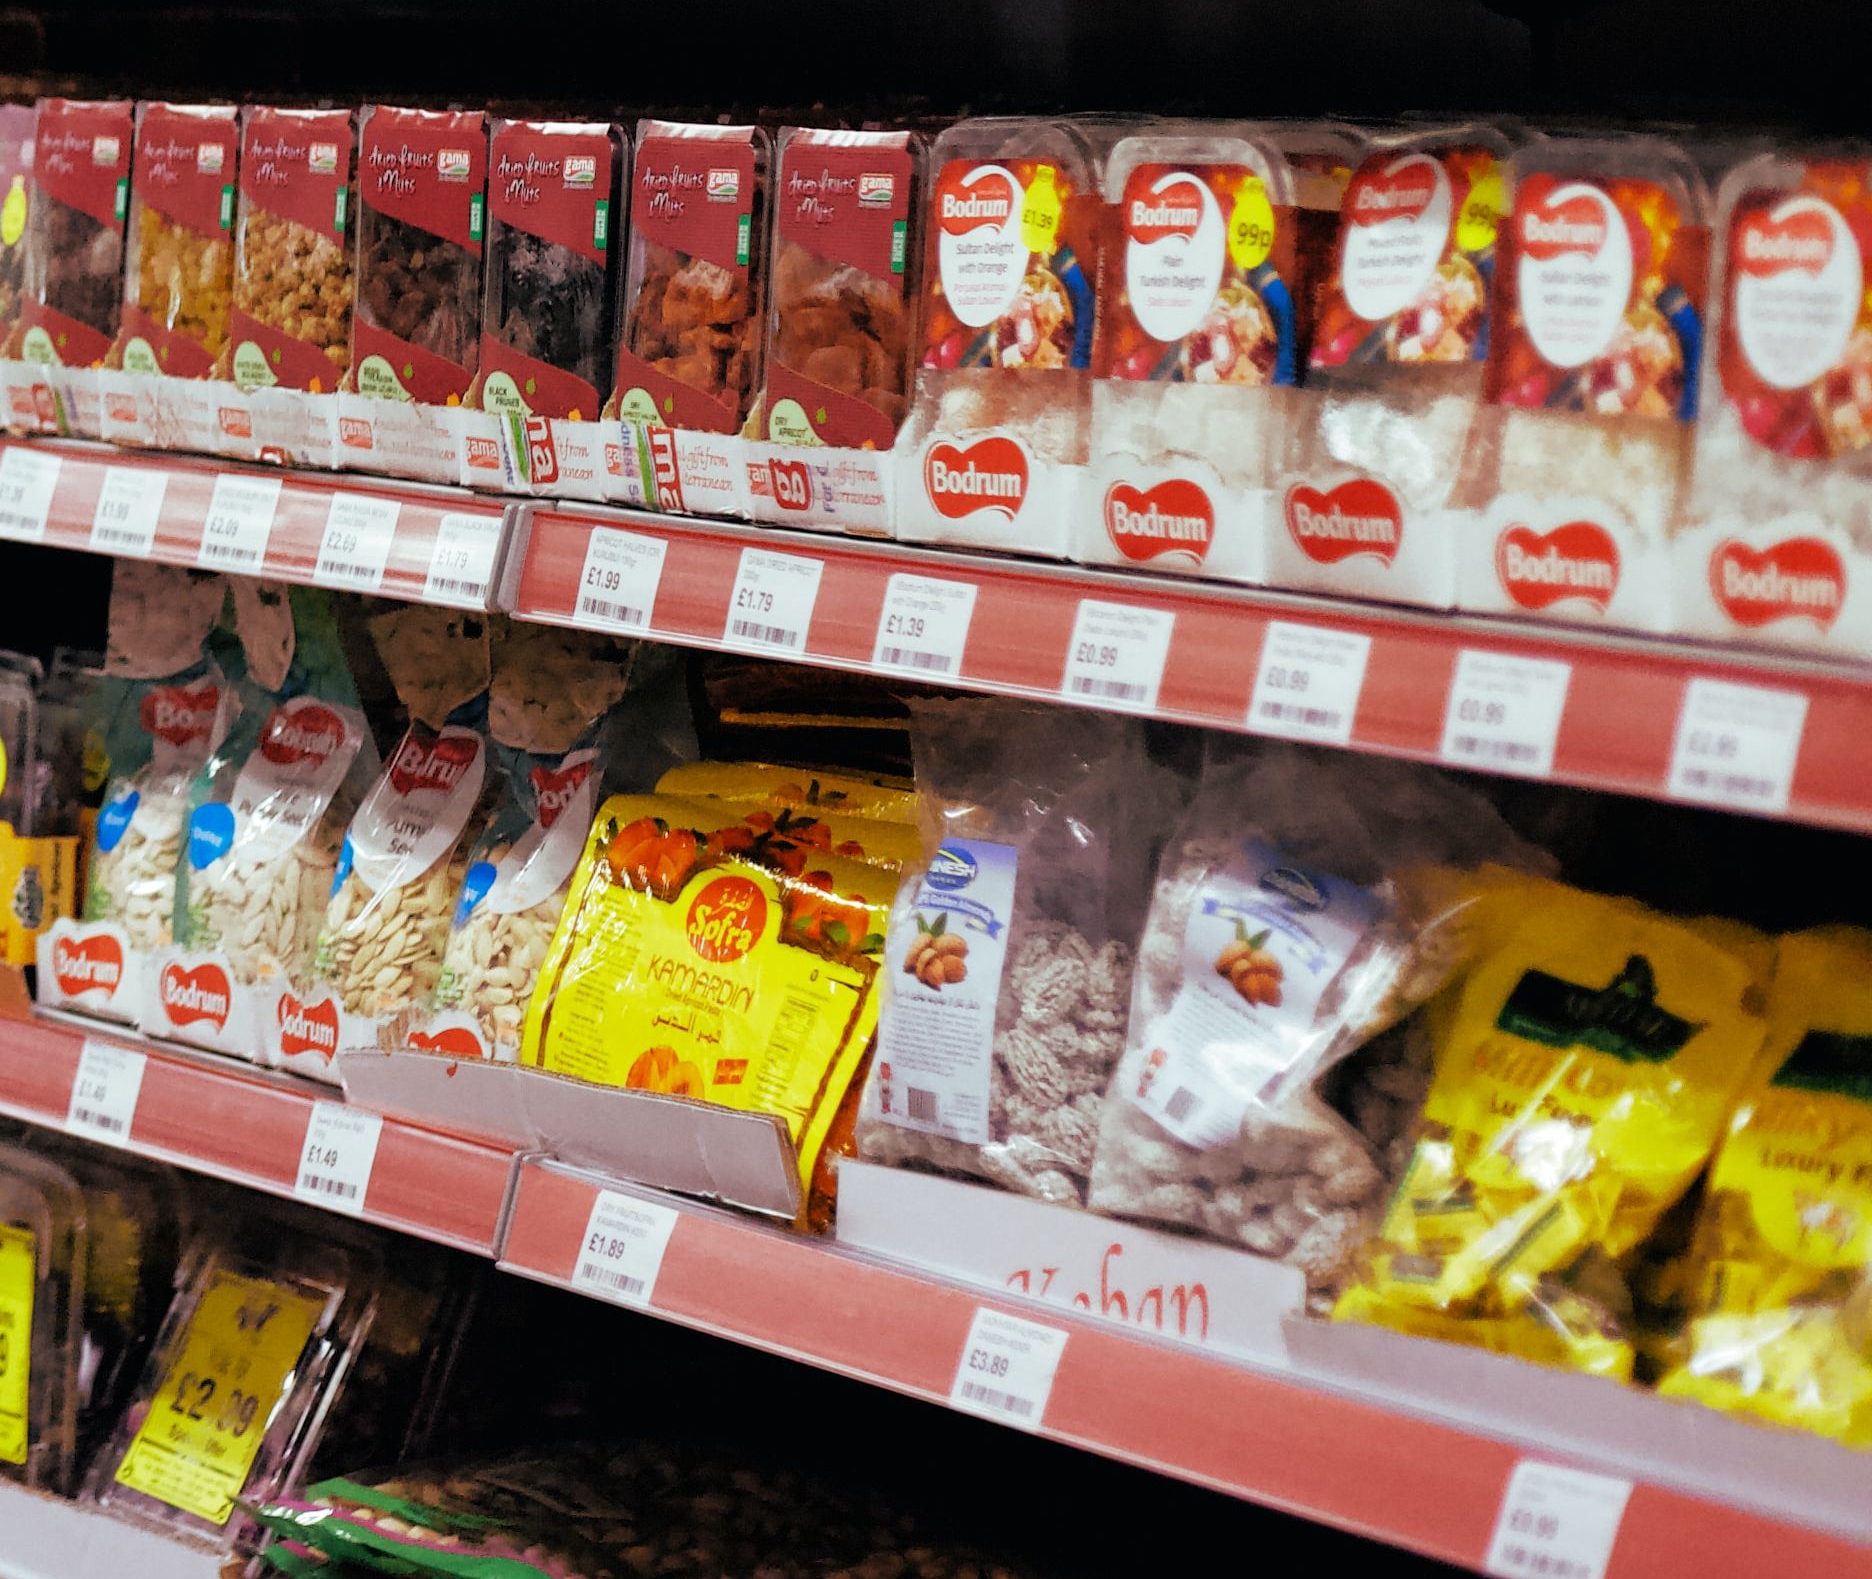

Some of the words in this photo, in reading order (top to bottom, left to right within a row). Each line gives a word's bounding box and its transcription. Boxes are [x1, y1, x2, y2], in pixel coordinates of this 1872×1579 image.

[438, 151, 470, 169] gama
[564, 158, 595, 172] gama
[709, 172, 738, 186] gama
[861, 176, 893, 191] gama
[942, 192, 1008, 218] Bodrum
[1132, 200, 1198, 227] Bodrum
[1023, 209, 1052, 230] £1.39
[1236, 222, 1271, 248] 99p
[932, 458, 1022, 499] Bodrum
[1111, 497, 1207, 541] Bodrum
[1292, 500, 1395, 544] Bodrum
[327, 531, 356, 553] £2.69
[437, 550, 468, 569] £1.79
[1504, 543, 1612, 590] Bodrum
[586, 566, 621, 591] £1.99
[1720, 558, 1836, 607] Bodrum
[737, 587, 773, 613] £1.79
[886, 615, 924, 638] £1.39
[1076, 642, 1118, 667] £0.99
[689, 904, 753, 952] Sofra
[58, 948, 119, 983] Bodrum
[165, 974, 227, 1015] Bodrum
[647, 953, 754, 1013] KAMARDIN
[306, 1144, 338, 1167] £1.49
[588, 1232, 625, 1260] £1.89
[968, 1348, 1009, 1378] £3.89
